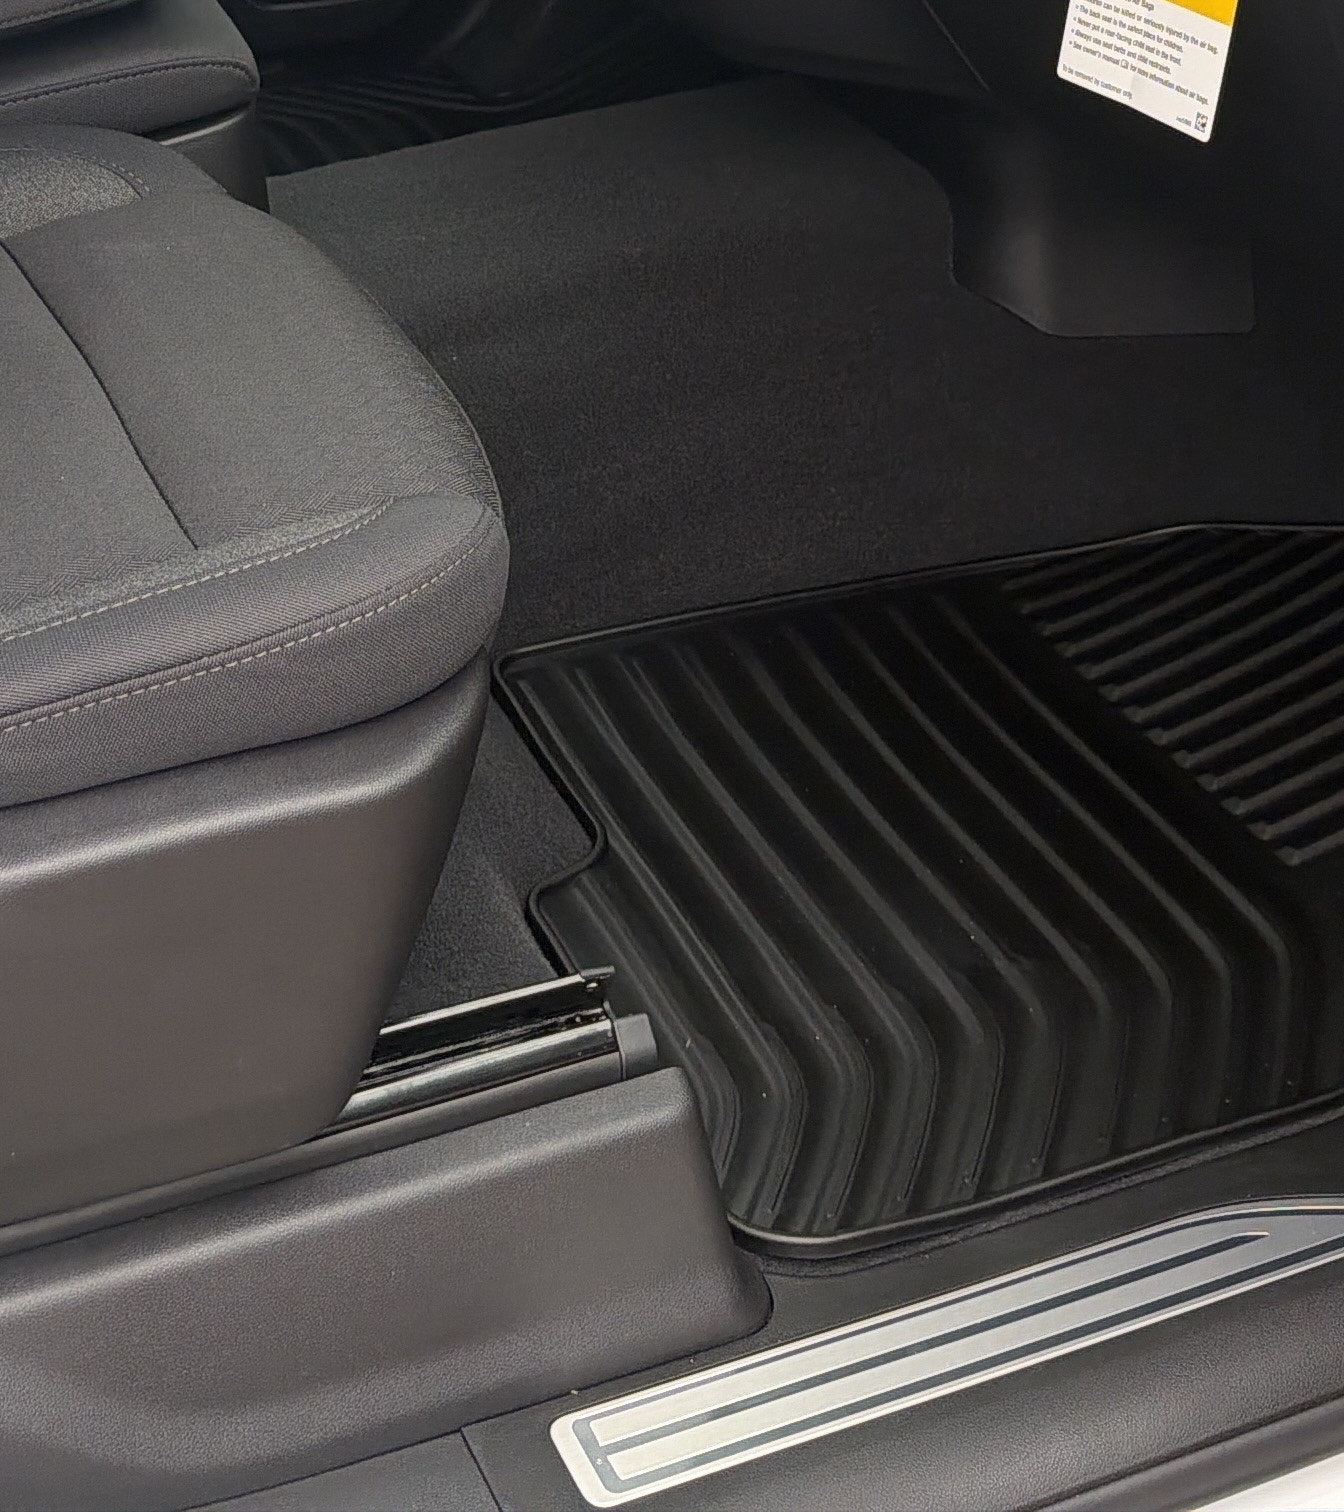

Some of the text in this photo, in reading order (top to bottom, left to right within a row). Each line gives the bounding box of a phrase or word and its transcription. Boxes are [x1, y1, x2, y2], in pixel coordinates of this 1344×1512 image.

[1075, 28, 1093, 42] Always
[1077, 17, 1092, 28] Never
[1132, 39, 1145, 49] child
[1080, 4, 1089, 14] The
[1089, 9, 1100, 18] back
[1127, 24, 1143, 35] safest
[1143, 30, 1156, 41] place
[1103, 2, 1113, 10] can
[1121, 8, 1136, 19] killed
[1143, 17, 1164, 32] seriously
[1165, 25, 1183, 39] injured
[1102, 53, 1120, 65] manual
[1175, 85, 1189, 96] about
